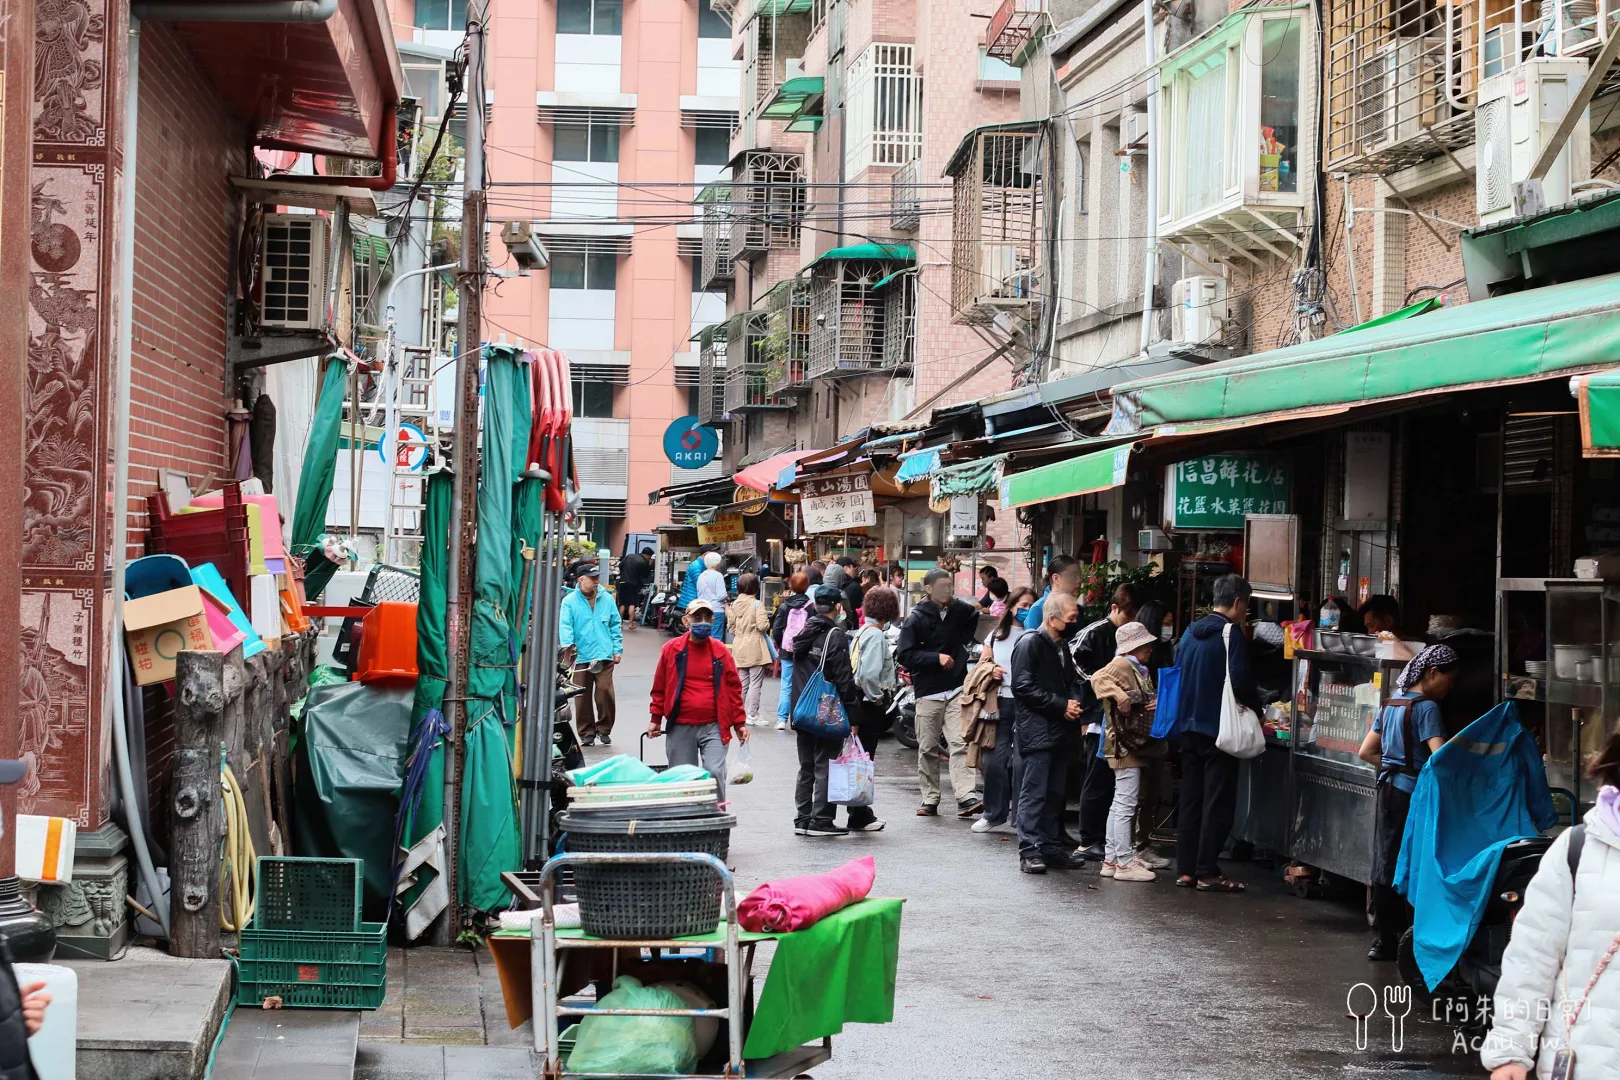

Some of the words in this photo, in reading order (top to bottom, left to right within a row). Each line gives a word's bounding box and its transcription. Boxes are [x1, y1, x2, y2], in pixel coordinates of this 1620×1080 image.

[675, 452, 707, 461] AKAI
[1176, 458, 1285, 488] 信昌鮮花店
[802, 474, 869, 498] 燕山湯圓
[810, 493, 865, 511] 鹹湯圓
[813, 510, 867, 528] 冬至圓
